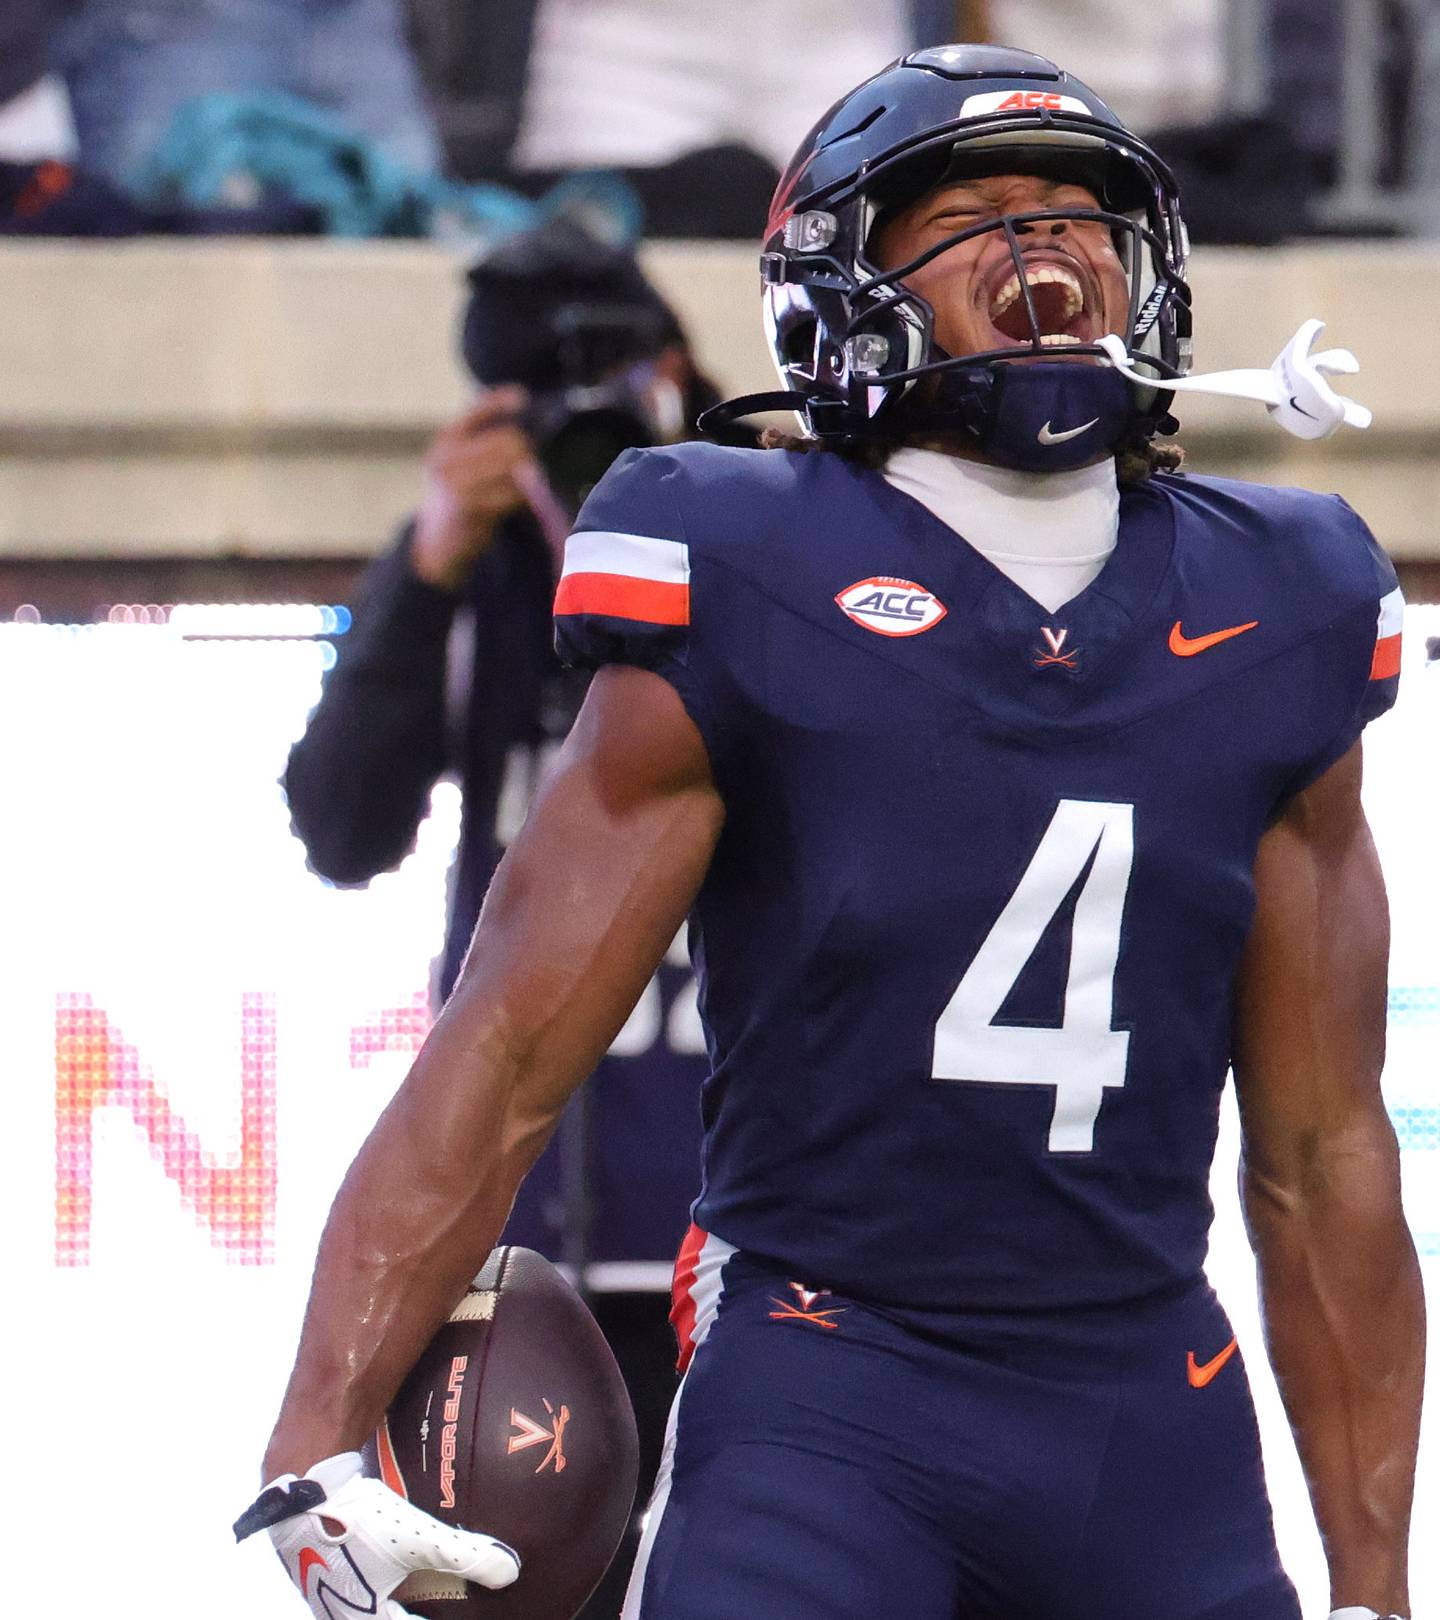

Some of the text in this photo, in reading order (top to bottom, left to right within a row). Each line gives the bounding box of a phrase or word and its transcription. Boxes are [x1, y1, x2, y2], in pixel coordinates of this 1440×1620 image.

[993, 92, 1062, 111] ACC
[852, 591, 930, 617] ACC
[931, 798, 1135, 1153] 4
[440, 1355, 468, 1508] VAPOR ELITE
